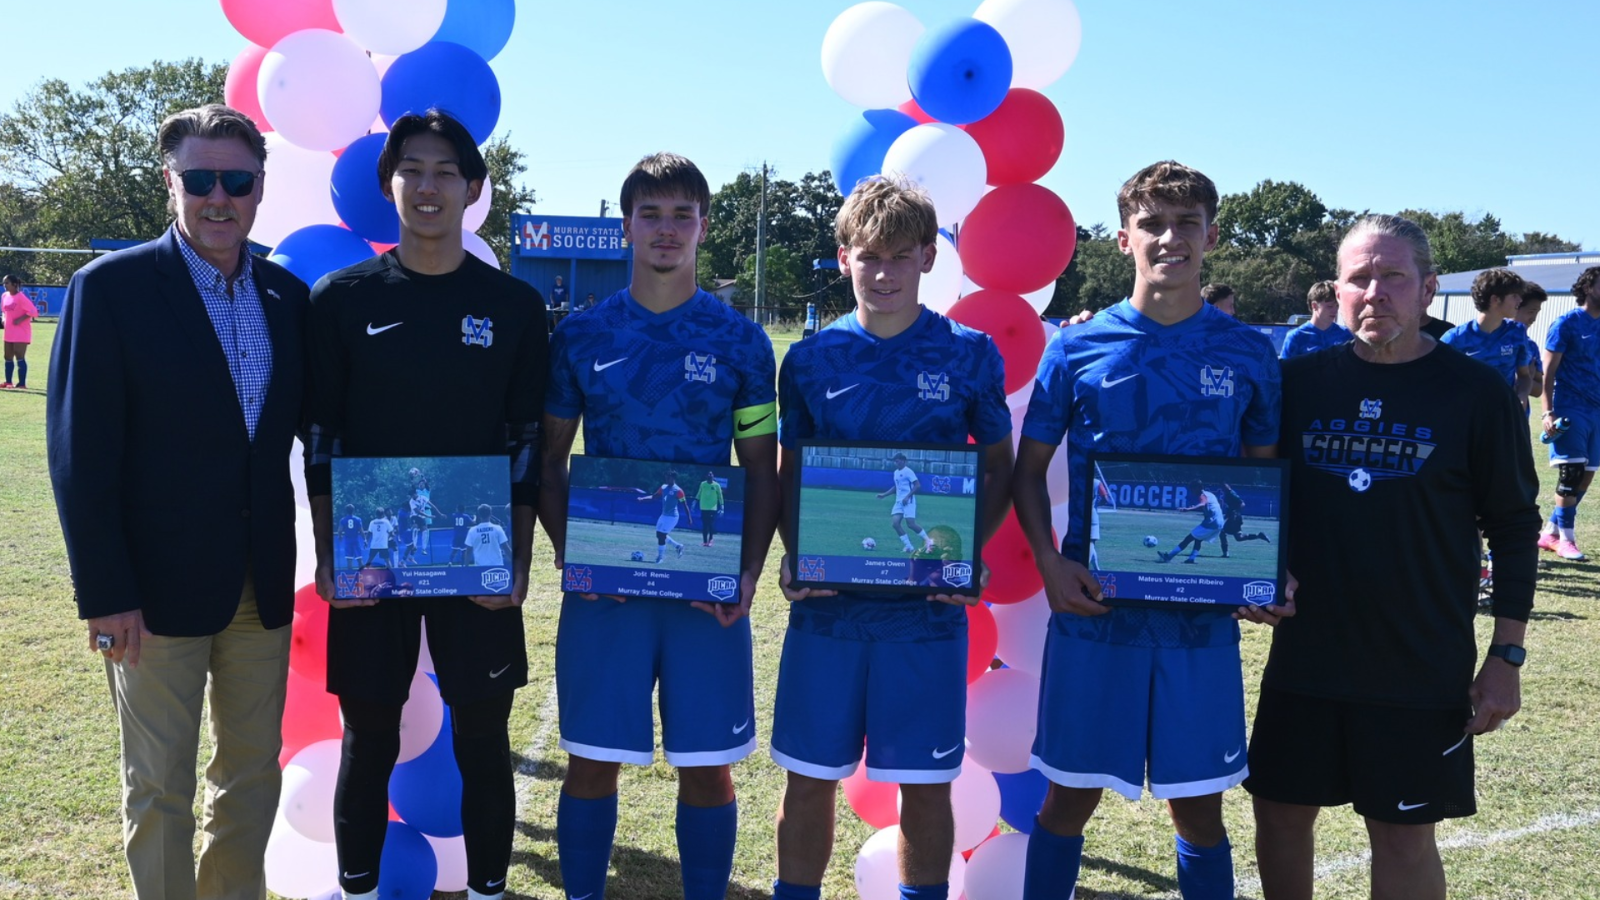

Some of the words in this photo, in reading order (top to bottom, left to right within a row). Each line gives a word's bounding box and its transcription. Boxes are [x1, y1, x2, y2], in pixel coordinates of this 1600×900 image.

[553, 226, 589, 235] MURRAY
[592, 228, 620, 236] STATE
[553, 235, 619, 250] SOCCER
[1309, 419, 1433, 440] AGGIES
[1308, 434, 1420, 473] SOCCER
[1108, 484, 1188, 508] SOCCER
[347, 518, 354, 529] 8
[455, 517, 464, 527] 10
[481, 533, 491, 545] 21
[864, 559, 886, 567] James
[650, 571, 670, 579] Remic
[1138, 575, 1163, 583] Mateus
[1164, 576, 1198, 585] Valsecchi
[1199, 578, 1225, 586] Ribeiro
[851, 577, 875, 585] Murray
[893, 578, 918, 587] College
[433, 587, 458, 595] College
[618, 587, 640, 596] Murray
[641, 588, 658, 597] State
[659, 590, 683, 598] College
[1144, 594, 1169, 602] Murray
[1170, 595, 1188, 603] State
[1189, 596, 1216, 605] College
